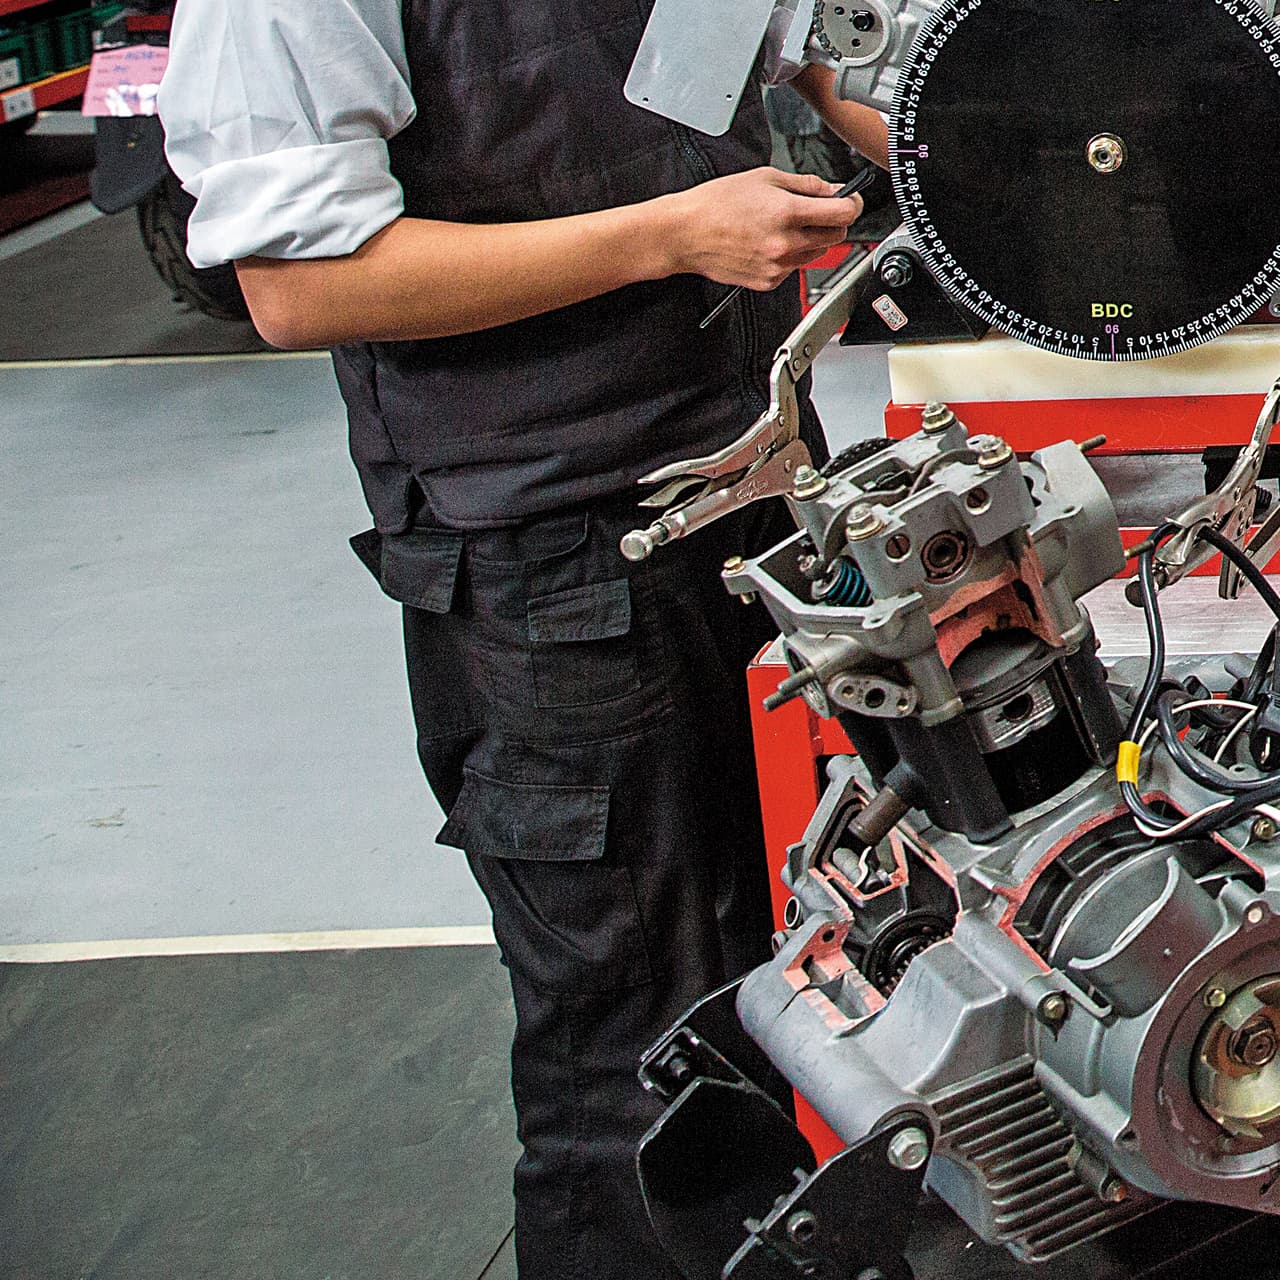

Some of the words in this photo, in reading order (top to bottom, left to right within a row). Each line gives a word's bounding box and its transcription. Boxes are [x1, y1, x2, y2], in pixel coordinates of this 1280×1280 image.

[955, 9, 969, 22] 45
[944, 20, 958, 35] 50
[1223, 2, 1238, 15] 40
[1236, 14, 1251, 27] 45
[1248, 25, 1263, 40] 50
[1259, 39, 1273, 54] 55
[934, 34, 948, 48] 55
[925, 47, 938, 62] 60
[918, 62, 931, 77] 65
[912, 78, 925, 92] 70
[908, 94, 920, 108] 75
[906, 110, 916, 125] 80
[905, 127, 915, 141] 85
[919, 143, 929, 159] 90
[1091, 303, 1134, 318] BDC
[1105, 323, 1120, 334] 90
